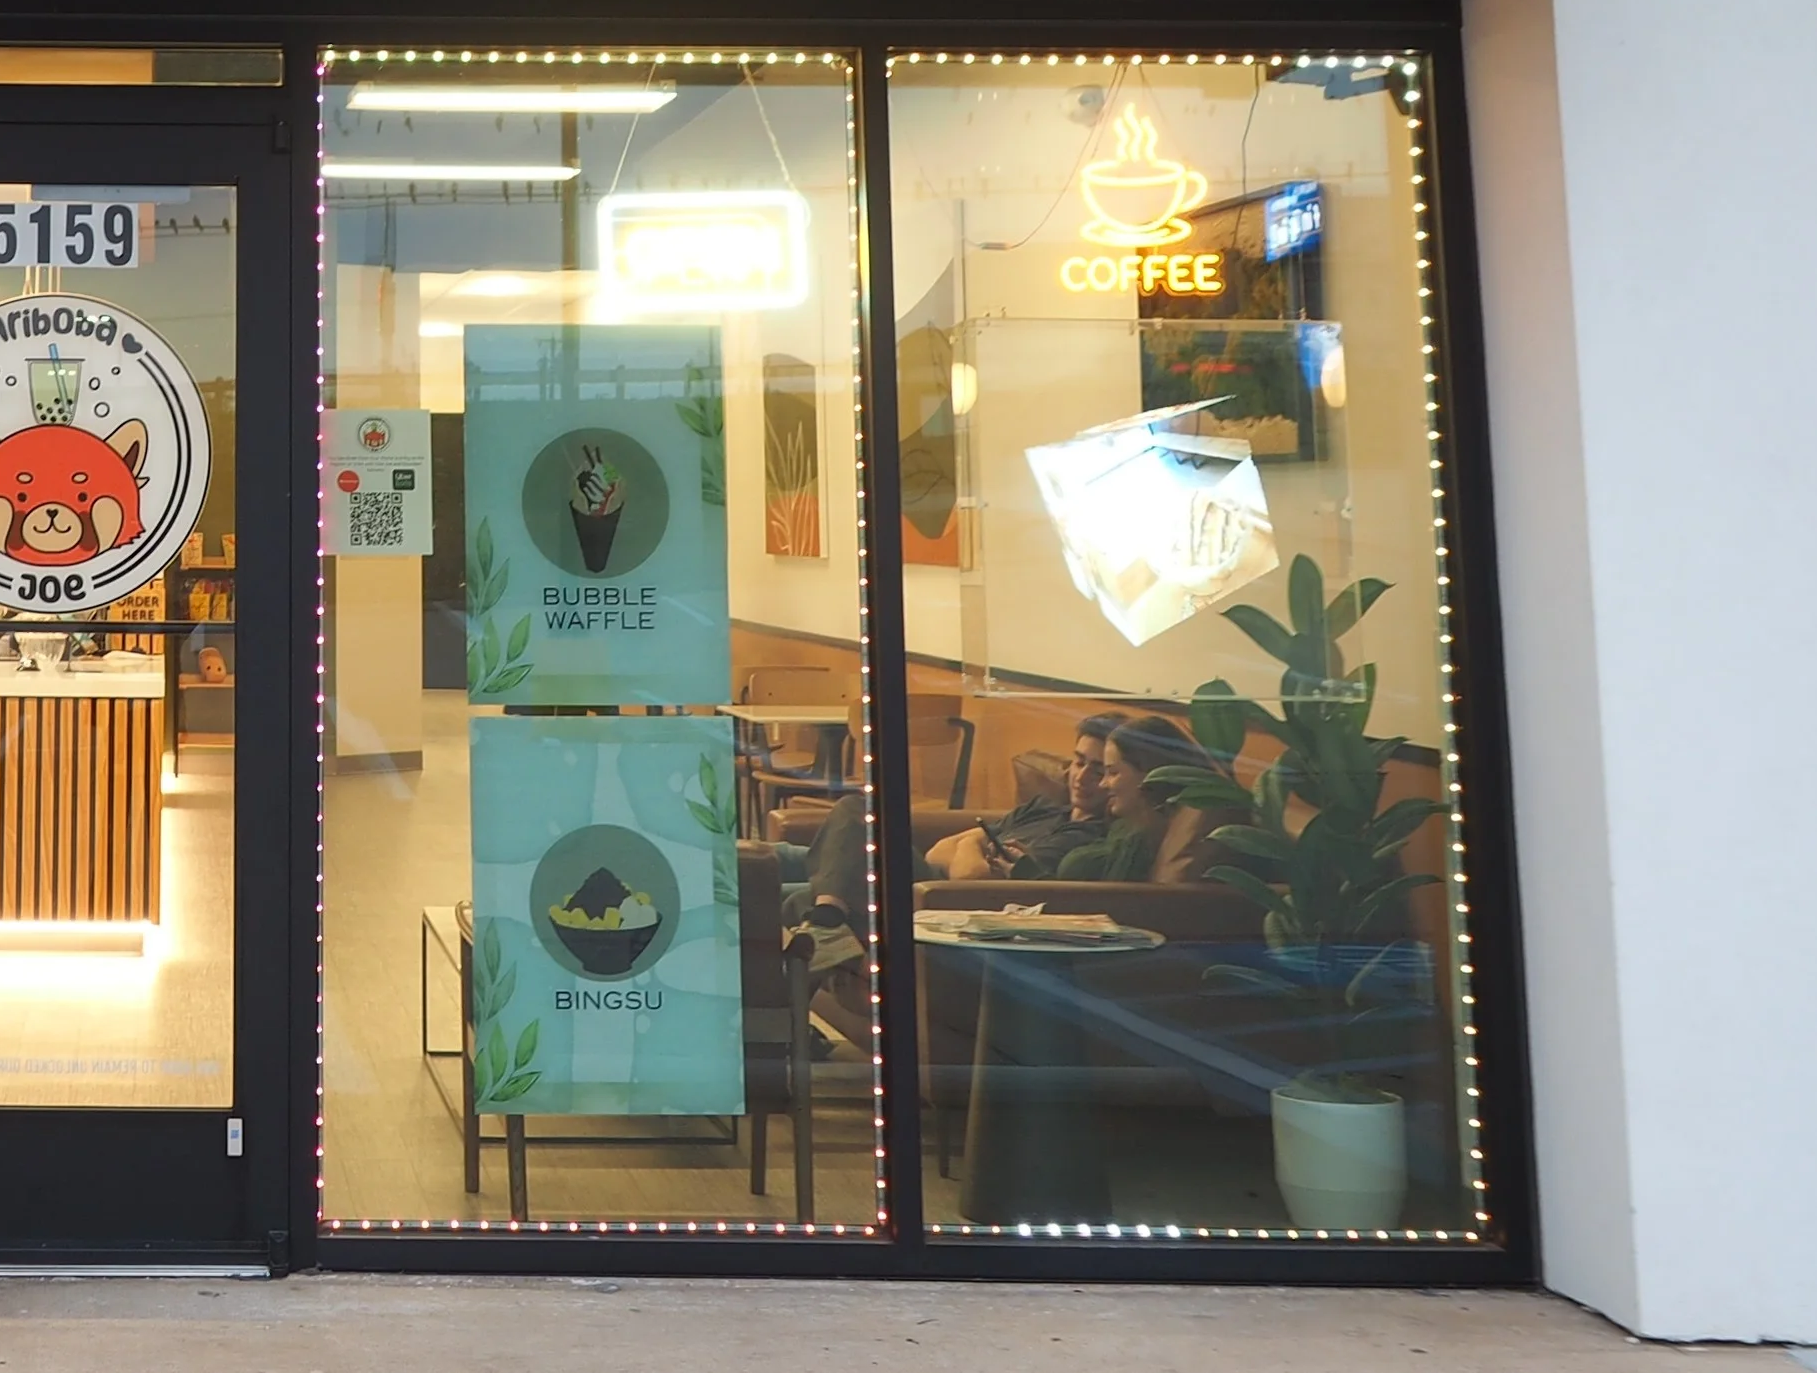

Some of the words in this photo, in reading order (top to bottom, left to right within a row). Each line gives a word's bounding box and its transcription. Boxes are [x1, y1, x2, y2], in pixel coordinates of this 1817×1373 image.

[1059, 253, 1223, 293] COFFEE
[543, 587, 658, 606] BUBBLE
[122, 609, 156, 621] HERE
[544, 611, 656, 630] WAFFLE
[555, 991, 663, 1010] BINGSU
